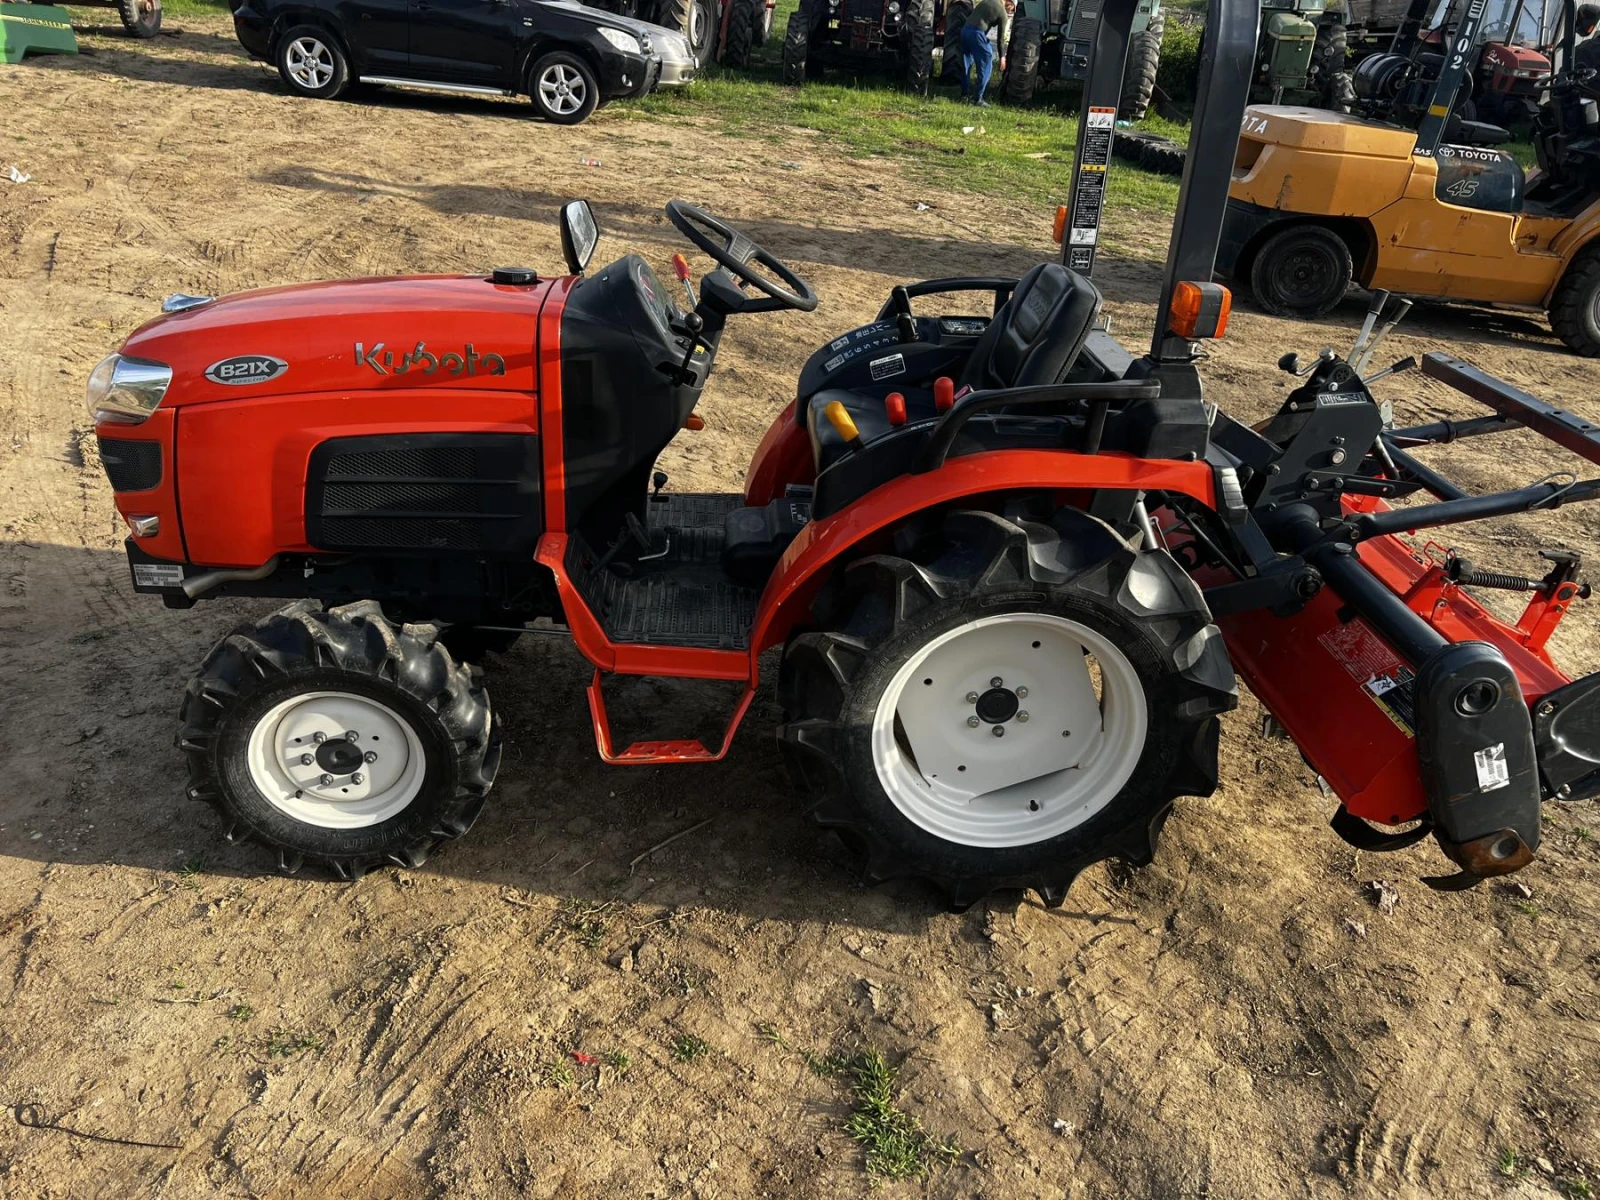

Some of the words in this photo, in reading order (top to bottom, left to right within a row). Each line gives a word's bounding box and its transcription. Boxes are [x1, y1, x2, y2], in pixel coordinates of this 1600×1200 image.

[1414, 147, 1432, 156] SAS
[1458, 150, 1502, 163] TOYOTA
[1446, 180, 1480, 198] 45
[354, 341, 506, 376] Kubota
[220, 361, 271, 378] B21X
